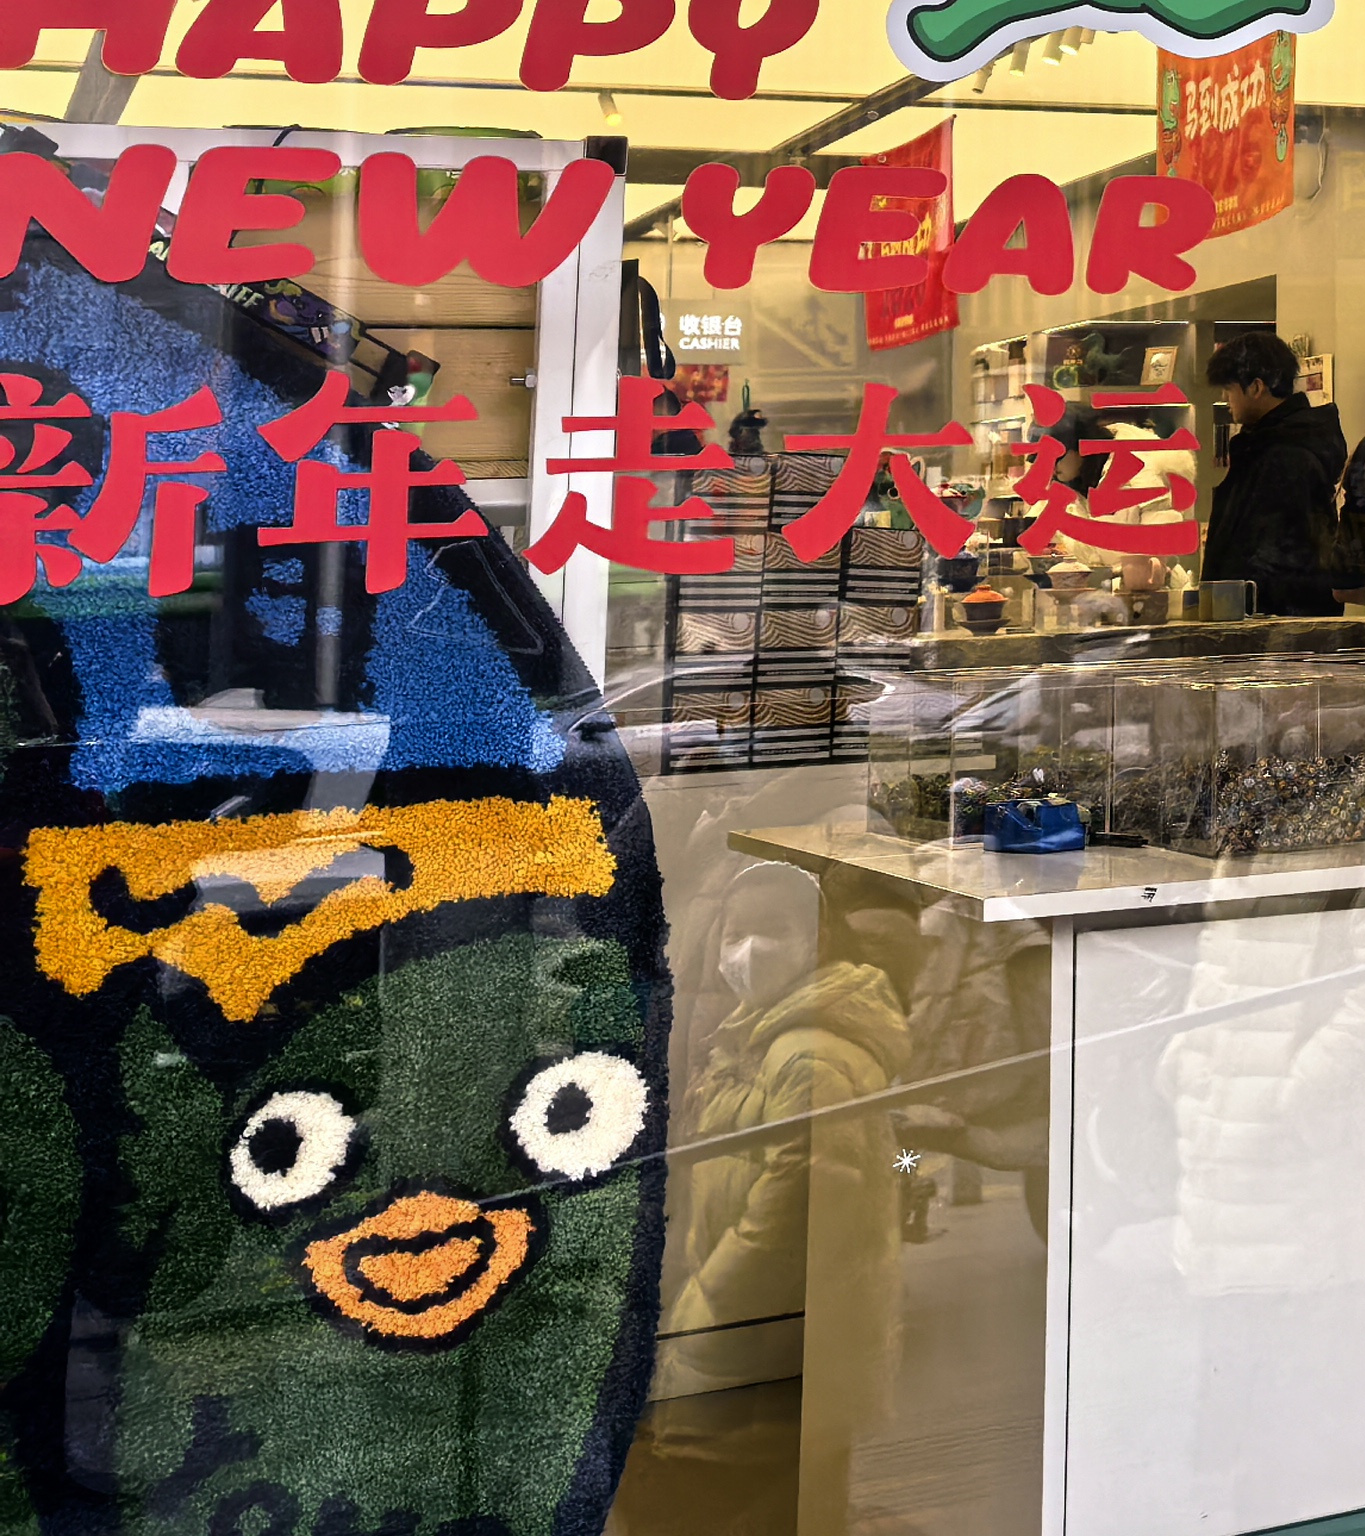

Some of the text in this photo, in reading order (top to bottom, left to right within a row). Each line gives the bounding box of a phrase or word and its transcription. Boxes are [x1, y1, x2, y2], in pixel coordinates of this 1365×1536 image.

[1184, 61, 1267, 141] 马到成功
[0, 143, 614, 288] NEW
[680, 163, 1216, 296] YEAR
[679, 314, 742, 337] 收银台
[679, 337, 740, 350] CASHIER
[0, 370, 1201, 606] 新年走大运
